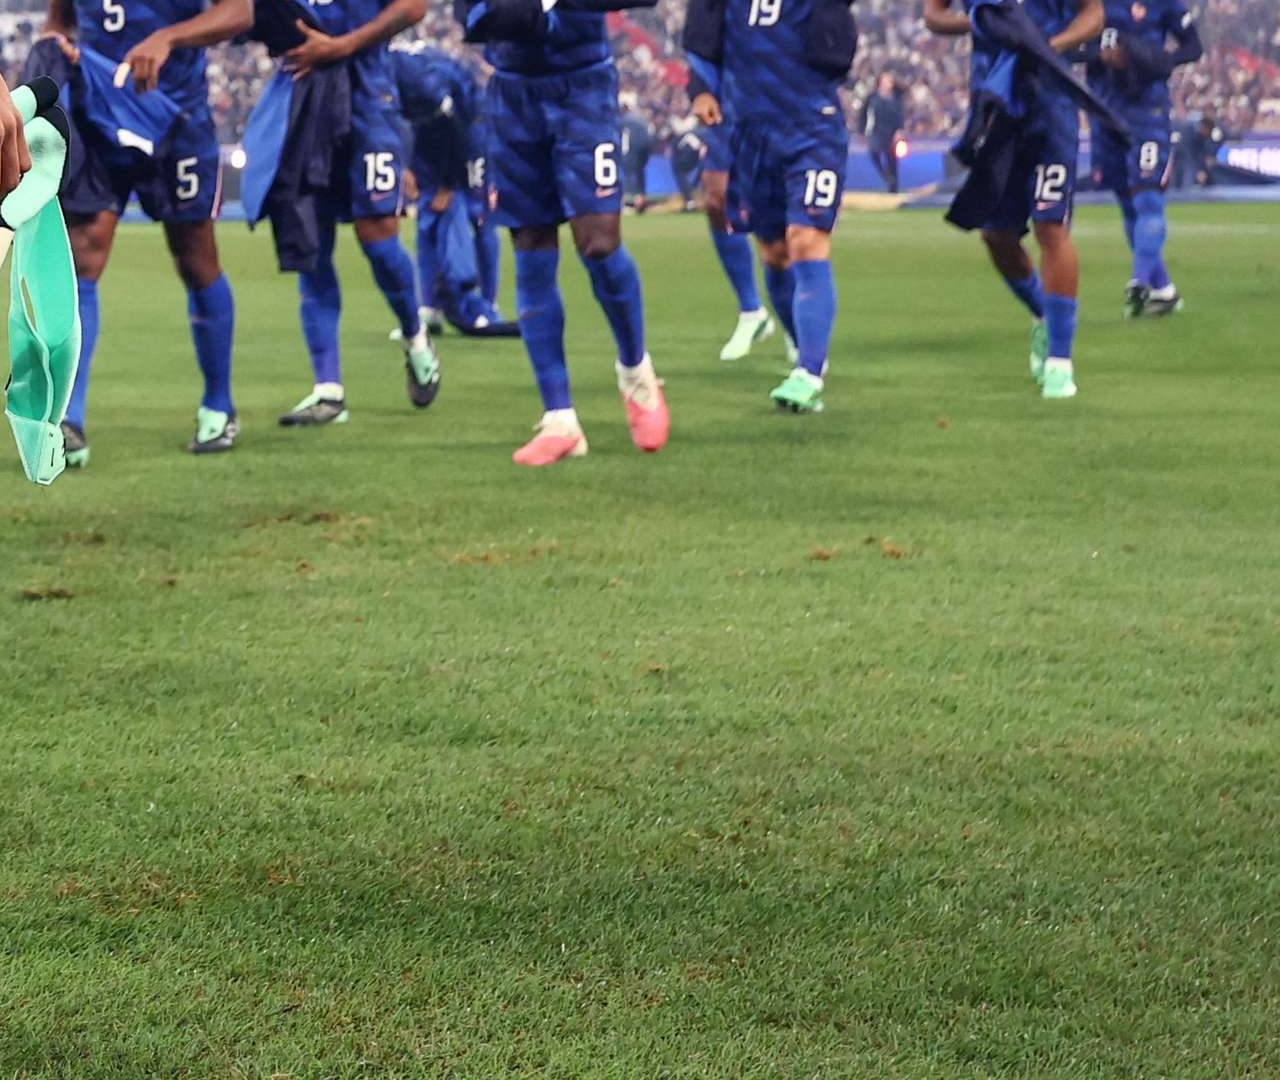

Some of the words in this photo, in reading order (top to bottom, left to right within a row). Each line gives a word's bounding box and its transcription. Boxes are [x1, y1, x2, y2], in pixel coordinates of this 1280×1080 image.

[363, 151, 396, 191] 15
[594, 142, 617, 186] 6
[1140, 141, 1158, 170] 8
[176, 157, 200, 200] 5
[804, 169, 838, 207] 19
[1034, 164, 1067, 201] 12
